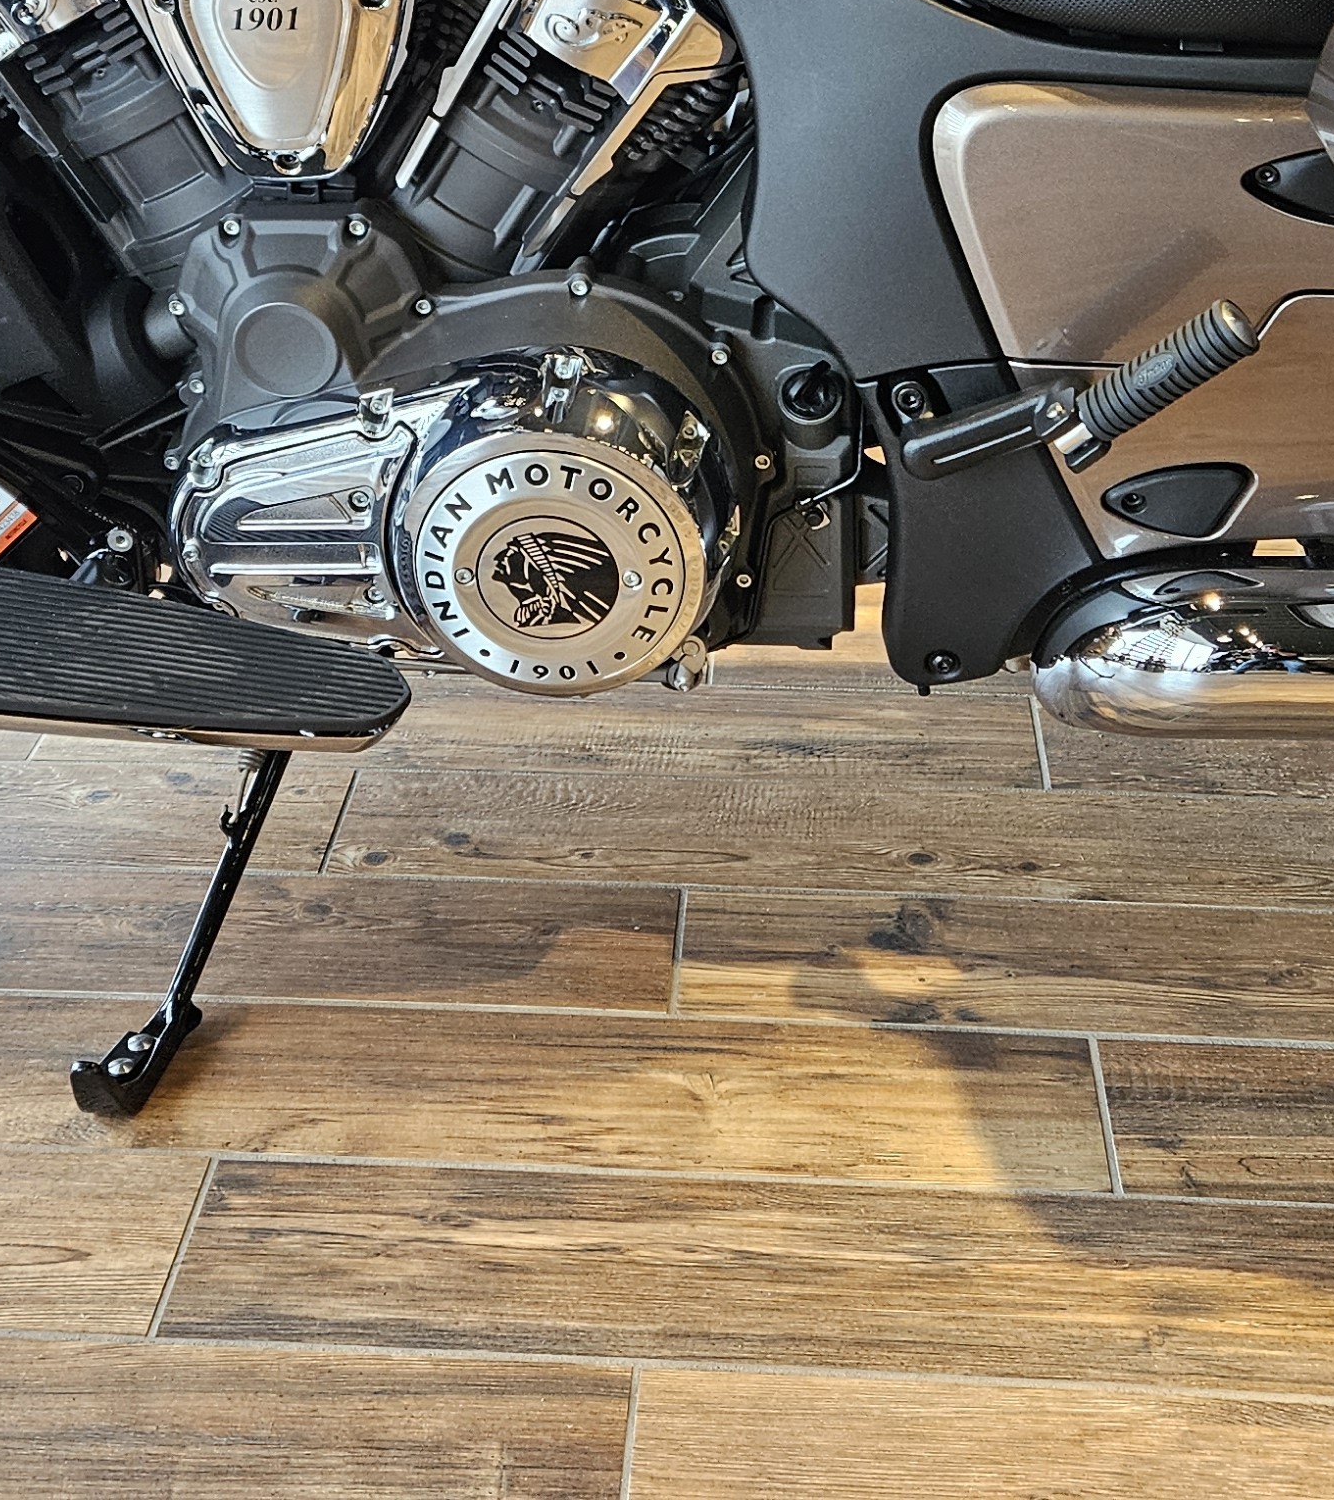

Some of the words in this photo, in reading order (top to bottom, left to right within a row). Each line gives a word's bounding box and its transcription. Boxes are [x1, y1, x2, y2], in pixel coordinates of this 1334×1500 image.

[231, 6, 299, 31] 1901
[424, 492, 473, 639] INDIAN
[485, 463, 674, 643] MOTORCYCLE
[509, 659, 600, 681] 1901
